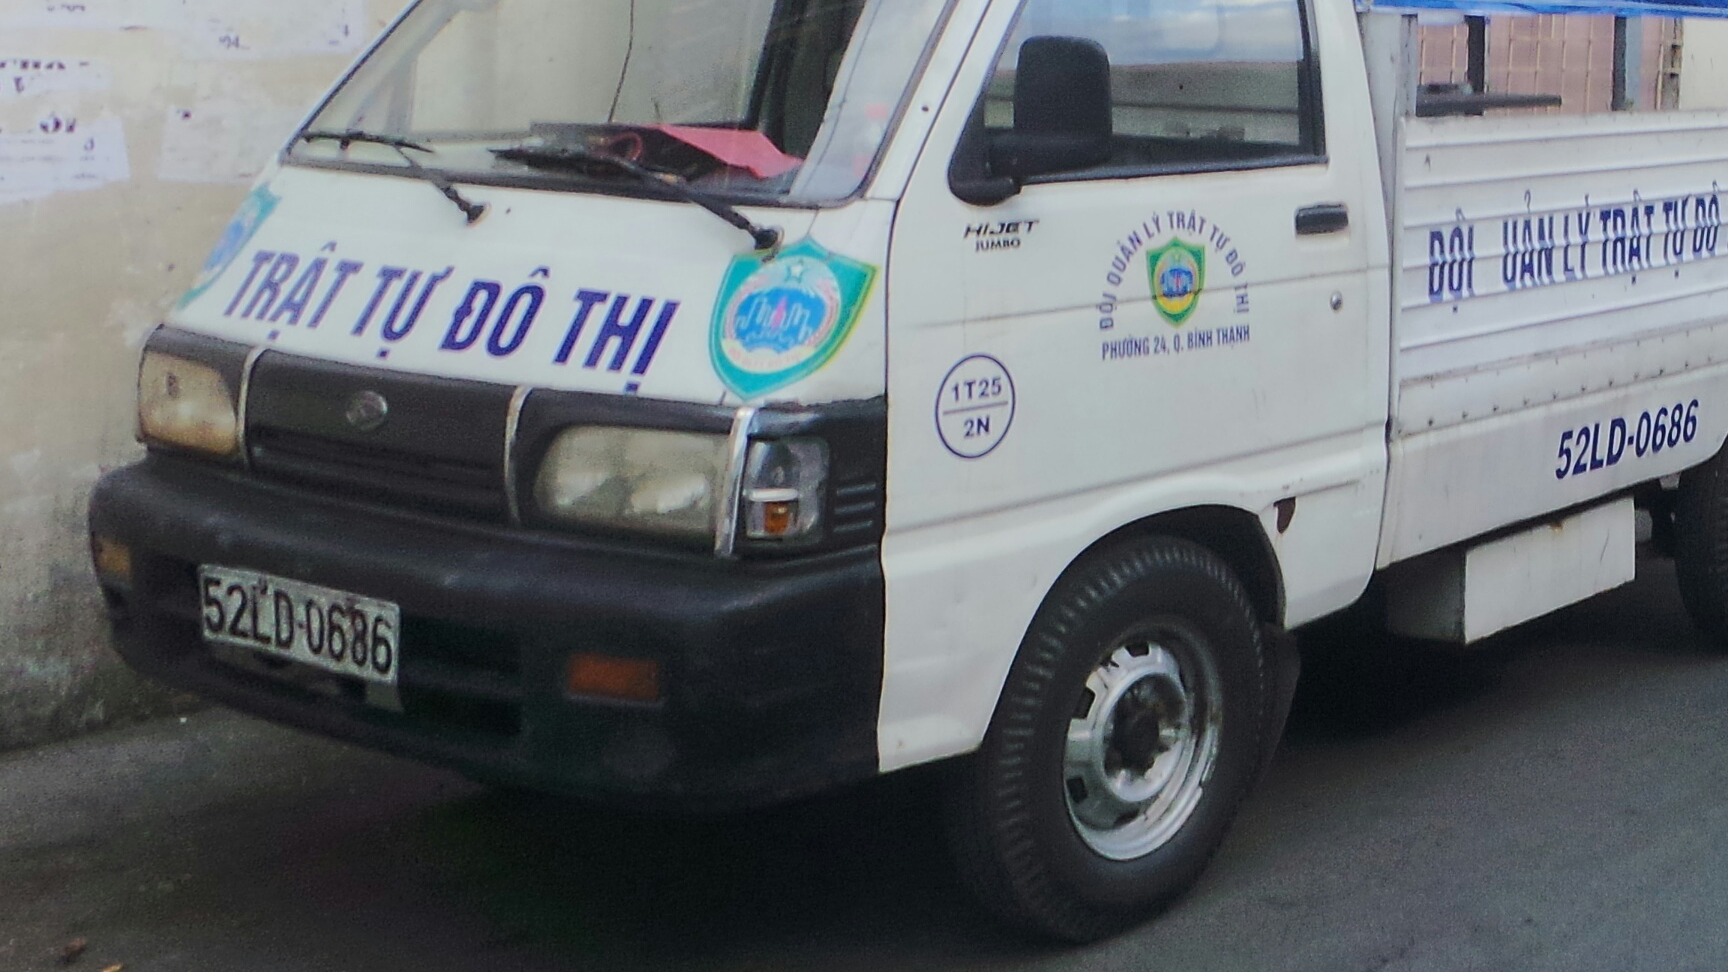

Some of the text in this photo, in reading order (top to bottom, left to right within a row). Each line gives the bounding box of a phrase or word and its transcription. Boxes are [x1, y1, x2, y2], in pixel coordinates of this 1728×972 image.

[975, 237, 1021, 252] JUMBO
[1143, 210, 1161, 239] LÝ
[1209, 224, 1231, 253] TỰ
[224, 241, 681, 394] TRẬT TỰ ĐÔ THỊ
[1101, 334, 1150, 361] PHƯỜNG
[952, 377, 1002, 402] 1T25
[964, 415, 990, 439] 2N
[1555, 398, 1699, 480] 52LD-0686
[204, 578, 393, 675] 52LD-0686
